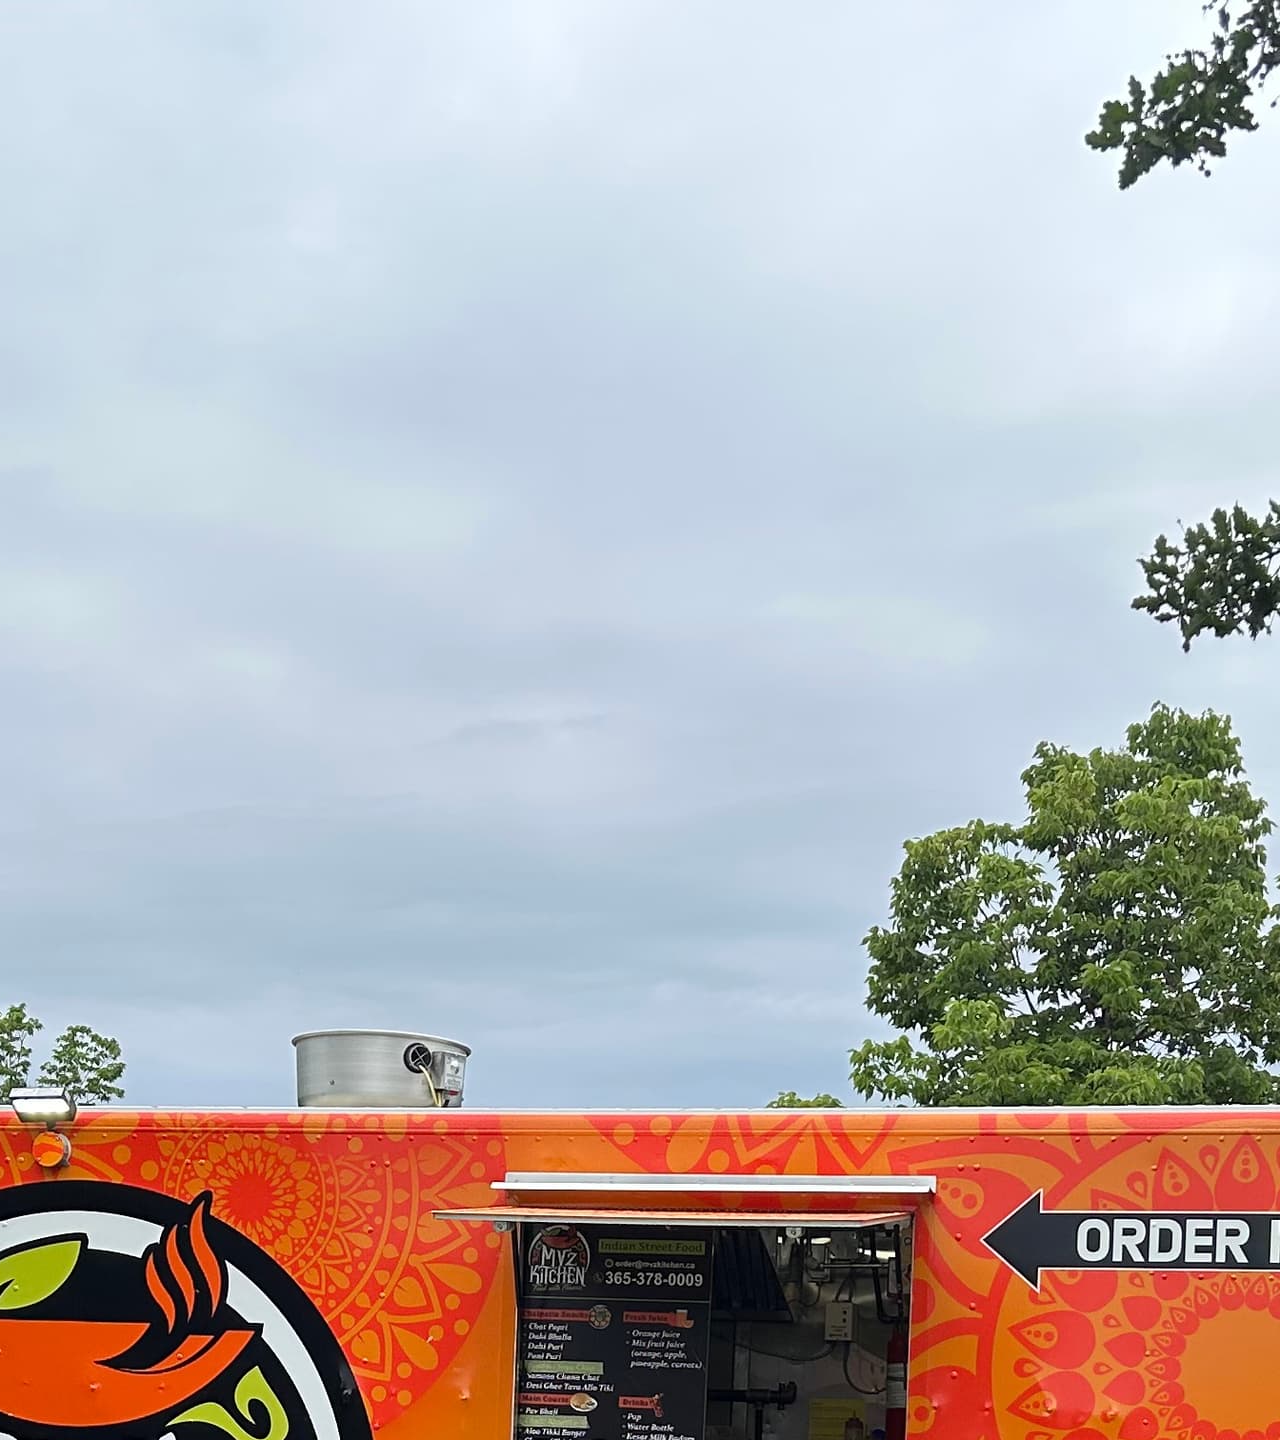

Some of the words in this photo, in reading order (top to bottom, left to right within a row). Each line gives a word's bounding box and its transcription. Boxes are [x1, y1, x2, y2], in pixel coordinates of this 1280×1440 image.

[600, 1240, 634, 1252] Indian
[638, 1241, 672, 1253] Street
[675, 1242, 704, 1254] Food
[1076, 1218, 1251, 1265] ORDER
[604, 1270, 705, 1288] 365-378-0009
[627, 1422, 650, 1431] Water
